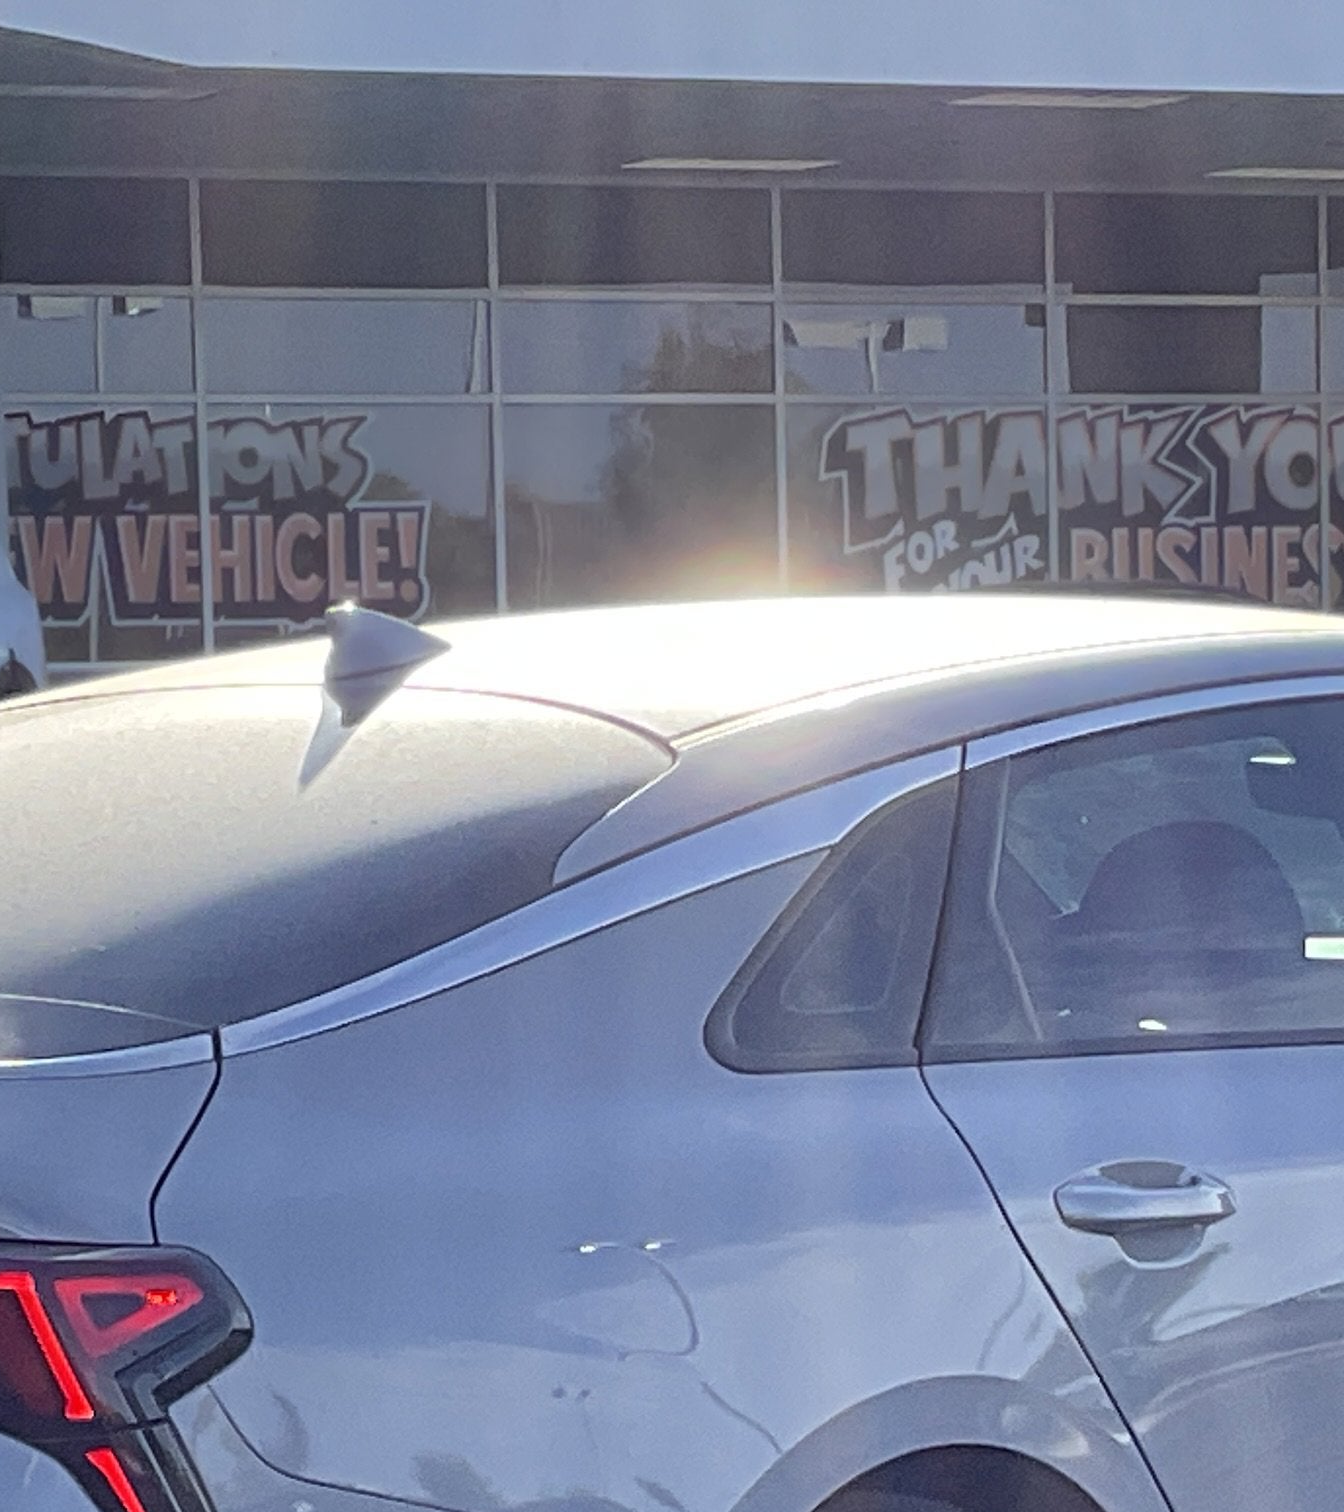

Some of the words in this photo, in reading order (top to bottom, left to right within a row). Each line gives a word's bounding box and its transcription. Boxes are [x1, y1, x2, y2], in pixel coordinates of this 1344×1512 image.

[846, 407, 1196, 518] THANK
[9, 513, 93, 603] W
[116, 511, 422, 603] VEHICLE!
[883, 519, 960, 592] FOR
